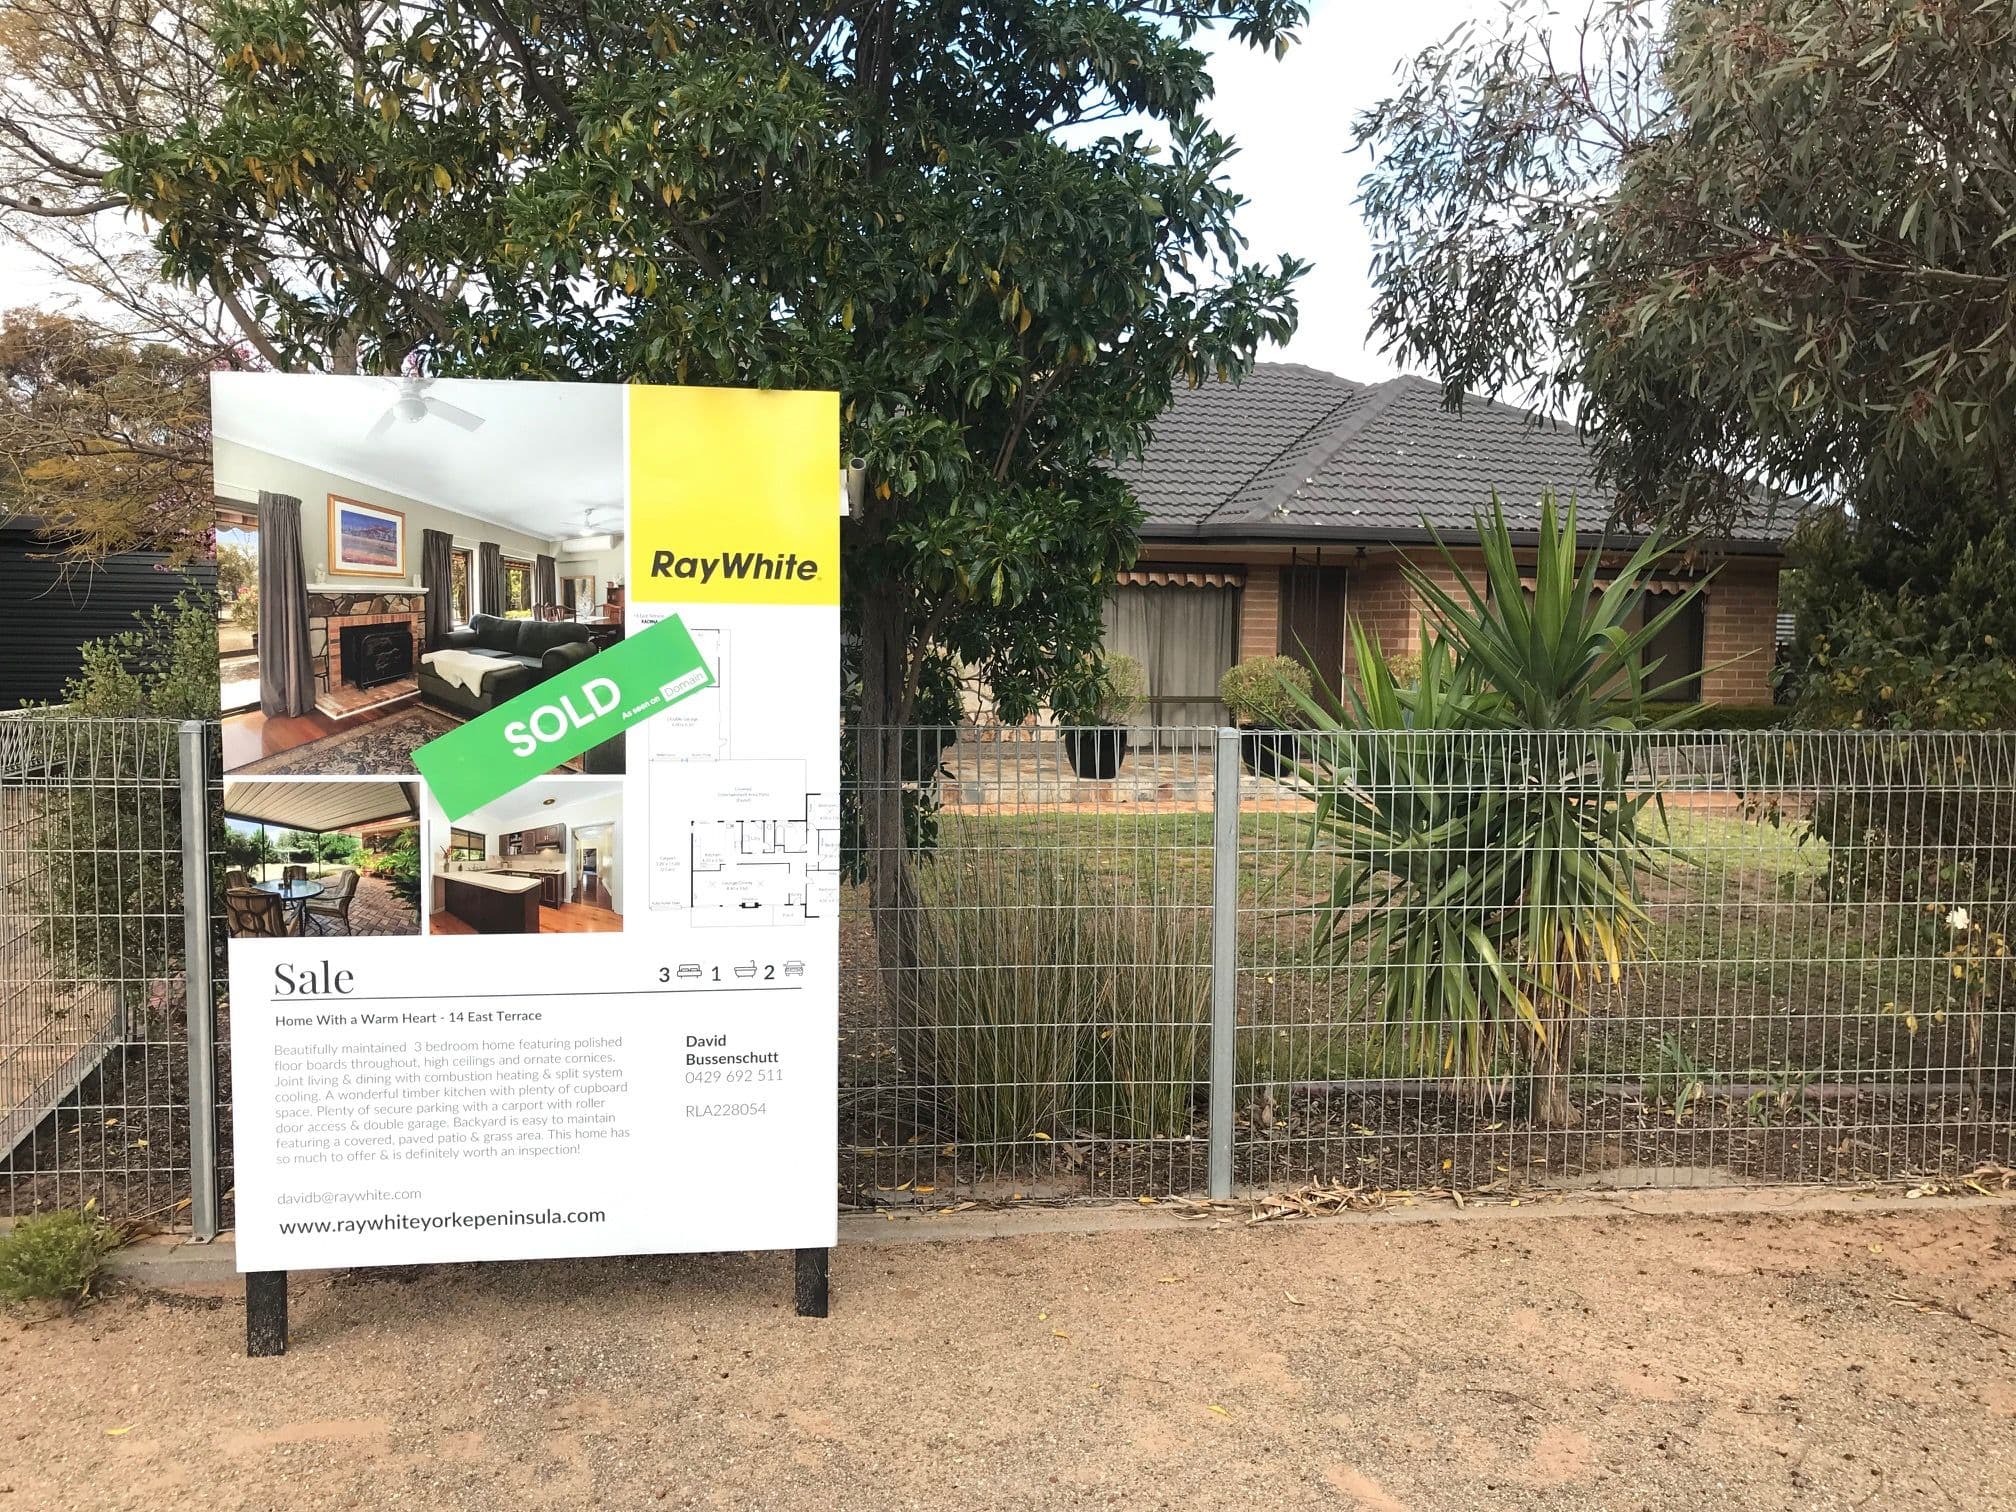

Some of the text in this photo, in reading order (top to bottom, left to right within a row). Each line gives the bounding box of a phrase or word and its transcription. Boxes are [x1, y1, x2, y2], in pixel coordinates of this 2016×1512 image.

[651, 551, 818, 584] RayWhite
[622, 671, 704, 720] As seen on Domain
[504, 677, 621, 757] SOLD
[275, 960, 354, 995] Sale
[659, 965, 775, 982] 3 1 2
[275, 1016, 312, 1026] Home
[317, 1014, 346, 1025] With
[351, 1016, 357, 1025] a
[361, 1014, 398, 1024] Warm
[403, 1013, 436, 1023] Heart
[449, 1012, 463, 1023] 14
[468, 1012, 493, 1022] East
[497, 1011, 541, 1021] Terrace
[275, 1037, 622, 1056] Beautifully maintained 3 bedroom home featuring polished
[686, 1035, 726, 1047] David
[275, 1053, 615, 1071] floor boards throughout, high ceilings and ornate cornices.
[686, 1052, 779, 1065] Bussenschutt
[275, 1068, 622, 1087] Joint living & dining with combustion heating & split system
[686, 1069, 782, 1084] 0429 692 511
[275, 1082, 628, 1103] cooling. A wonderful timber kitchen with plenty of cupboard
[275, 1109, 312, 1119] space.
[317, 1106, 354, 1117] Plenty
[358, 1105, 371, 1115] of
[374, 1105, 412, 1114] secure
[417, 1103, 459, 1114] parking
[463, 1101, 487, 1112] with
[502, 1100, 543, 1112] carport
[547, 1099, 572, 1109] with
[576, 1098, 605, 1108] roller
[686, 1103, 766, 1118] RLA228054
[276, 1113, 615, 1133] door access & double garage. Backyard is easy to maintain
[276, 1128, 630, 1149] featuring a covered, paved patio & grass area. This home has
[276, 1144, 580, 1164] so much to offer & is definitely worth an inspection!
[277, 1188, 422, 1205] davidb@raywhite.com
[279, 1209, 605, 1234] www.raywhiteyorkepeninsula.com
